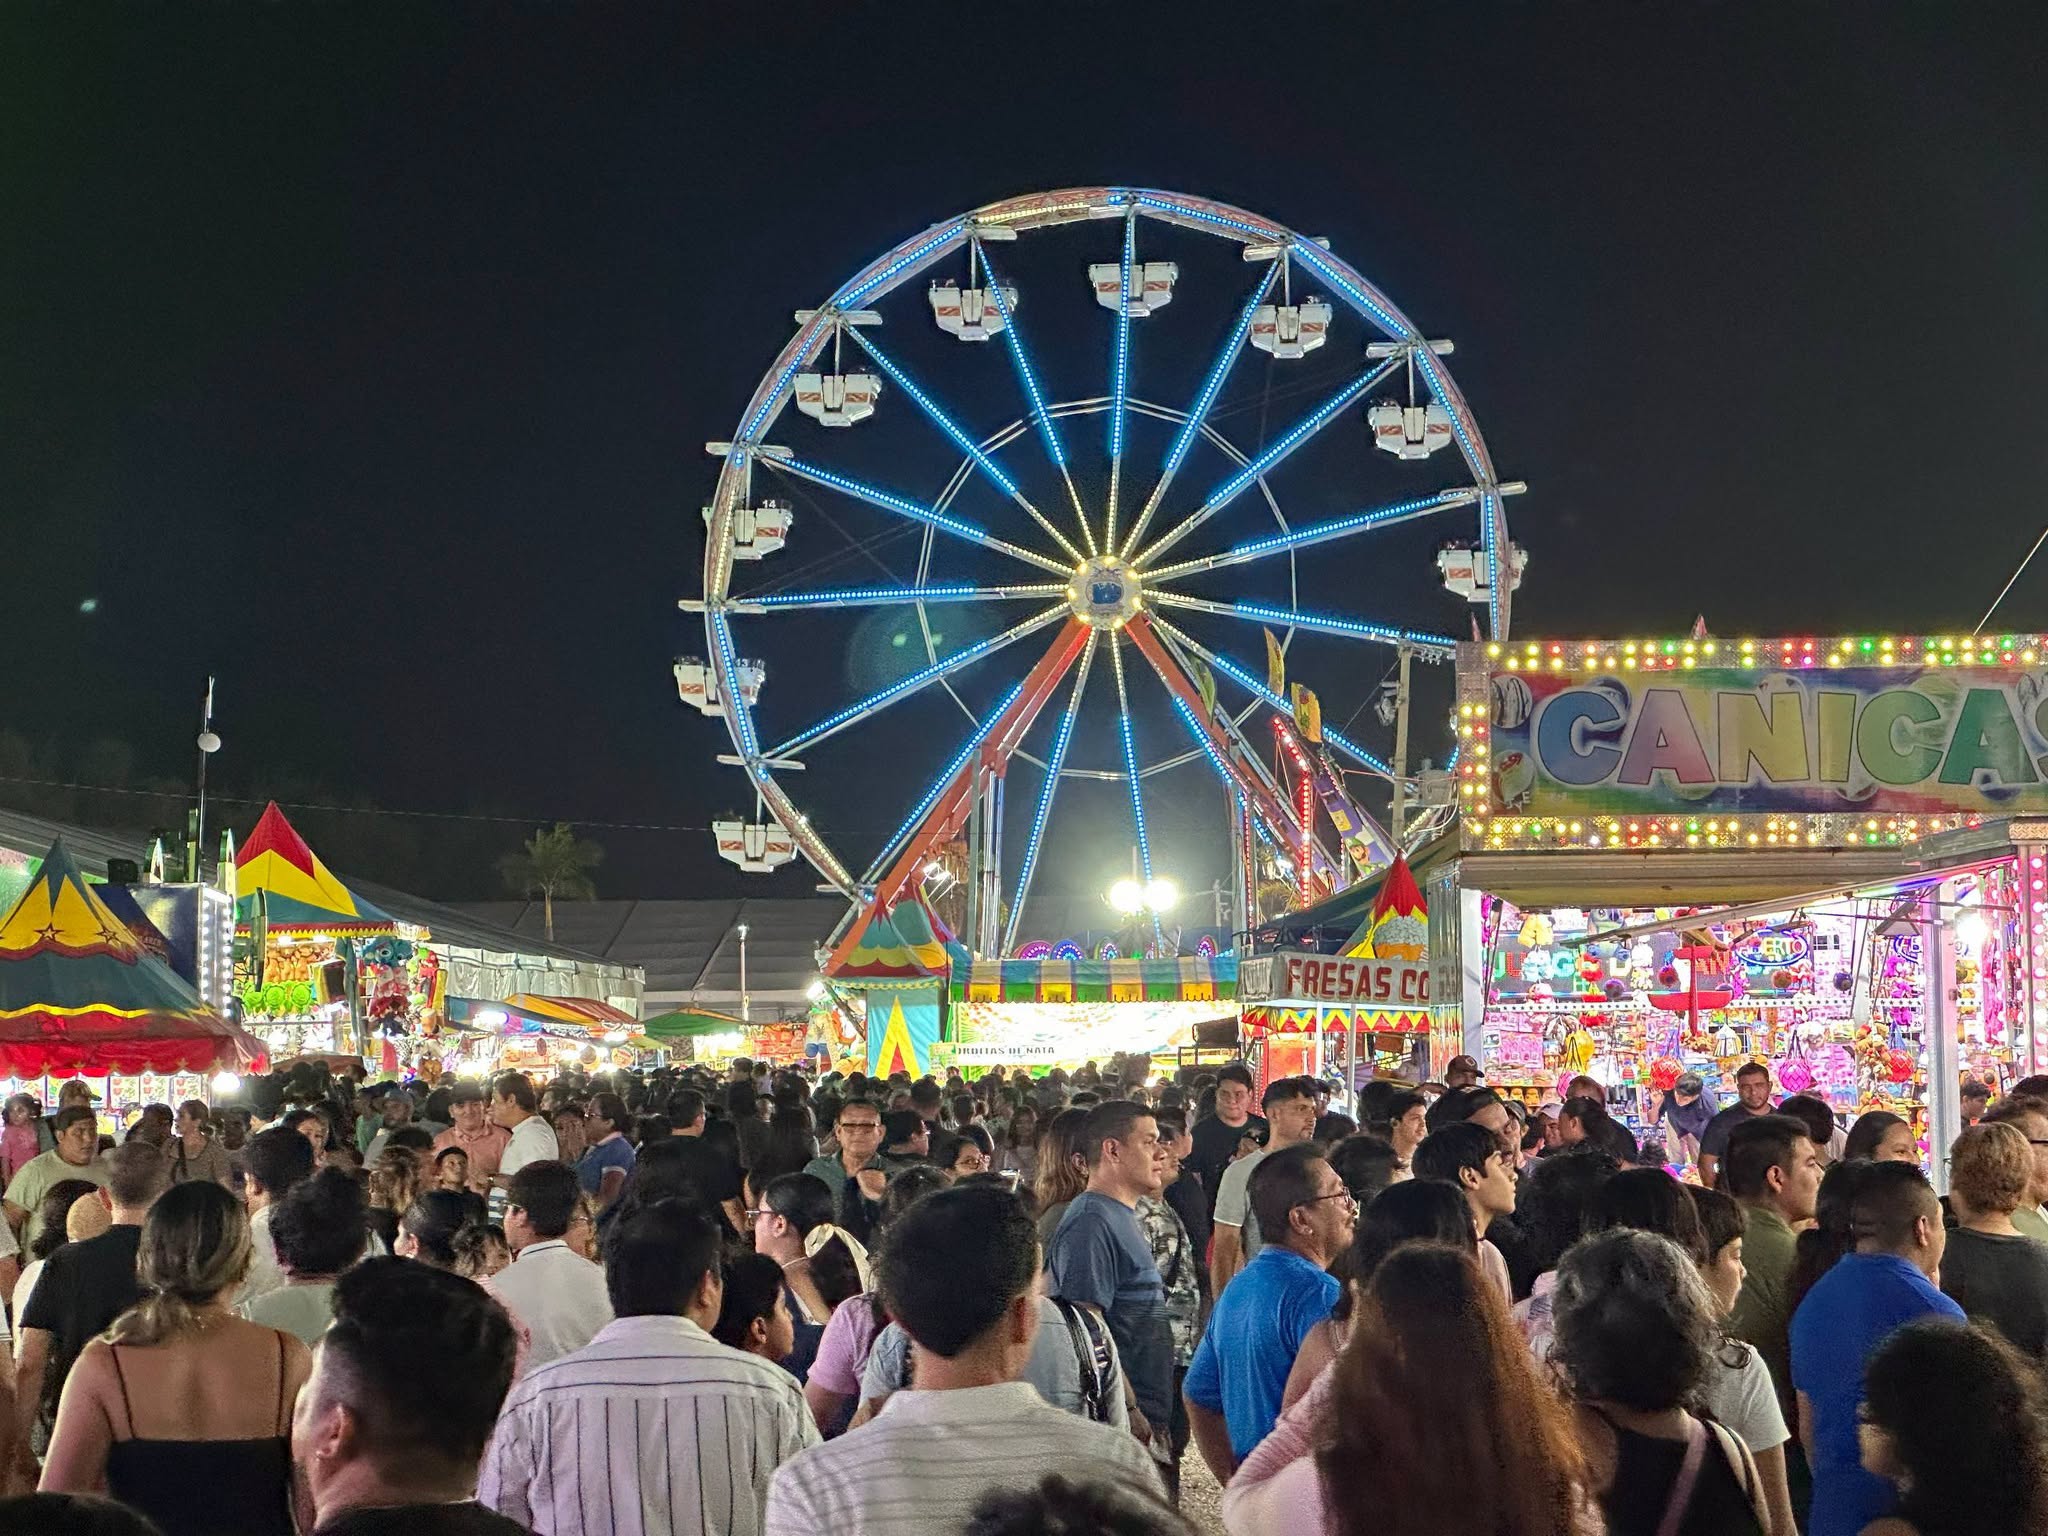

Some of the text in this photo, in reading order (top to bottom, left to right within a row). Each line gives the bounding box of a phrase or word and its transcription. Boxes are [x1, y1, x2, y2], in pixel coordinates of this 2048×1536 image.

[1537, 688, 2048, 785] CANICA
[1286, 958, 1393, 1002] FRESAS
[1026, 1046, 1055, 1054] NATA
